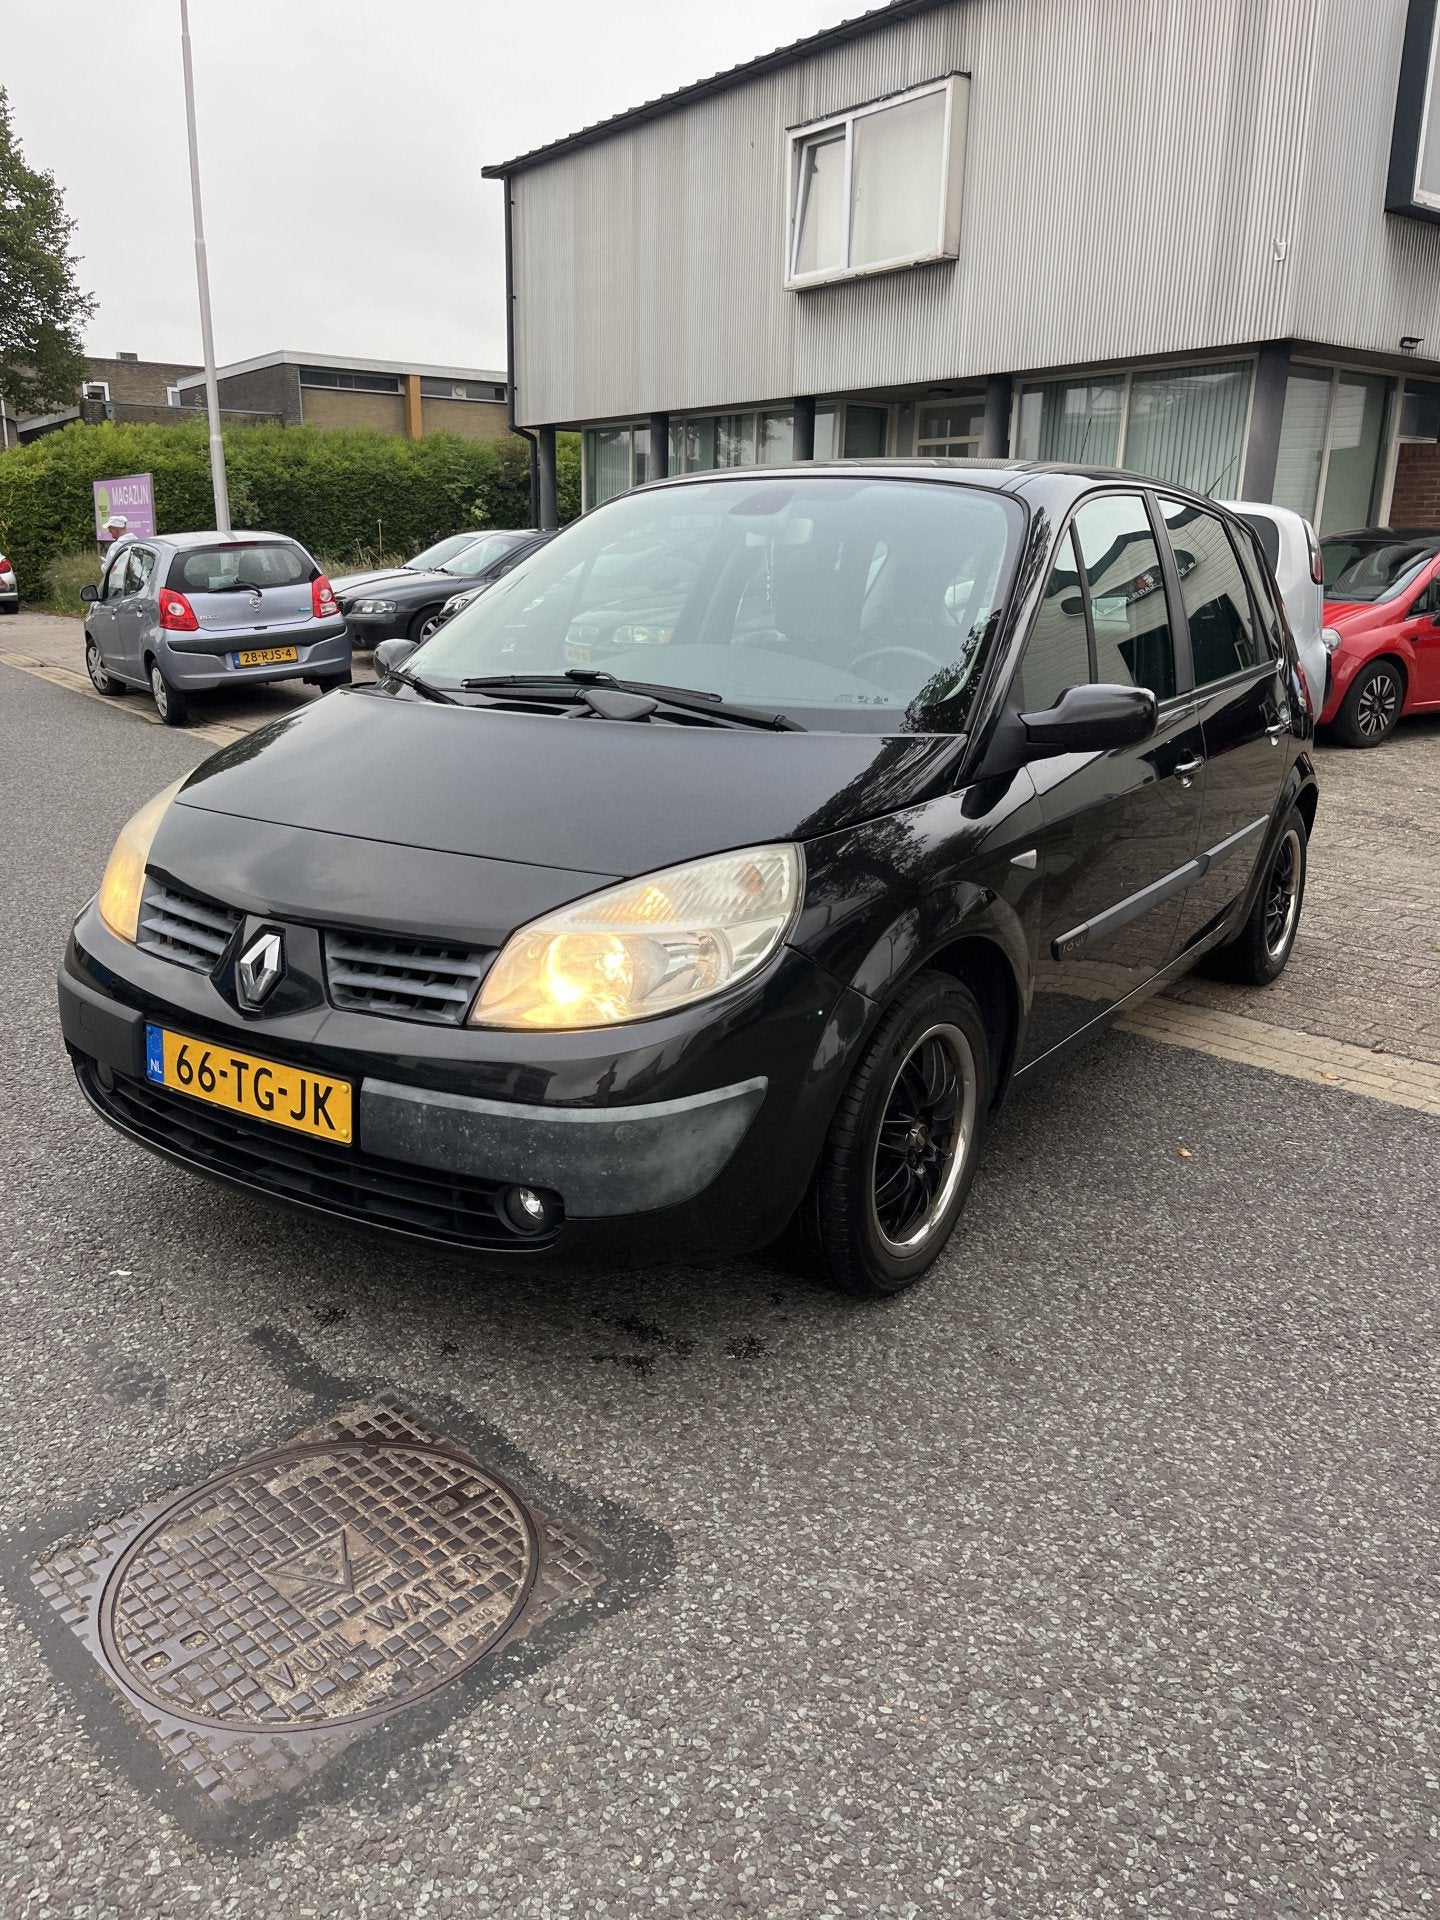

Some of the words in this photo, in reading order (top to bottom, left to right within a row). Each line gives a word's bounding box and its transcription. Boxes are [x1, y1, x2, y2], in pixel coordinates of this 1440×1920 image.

[112, 484, 149, 506] MAGAZIJN
[243, 648, 293, 664] 28-RJS-4
[149, 1058, 163, 1075] NL
[176, 1044, 336, 1131] 66-TG-JK
[365, 1553, 495, 1630] WATER
[470, 1607, 494, 1626] 400
